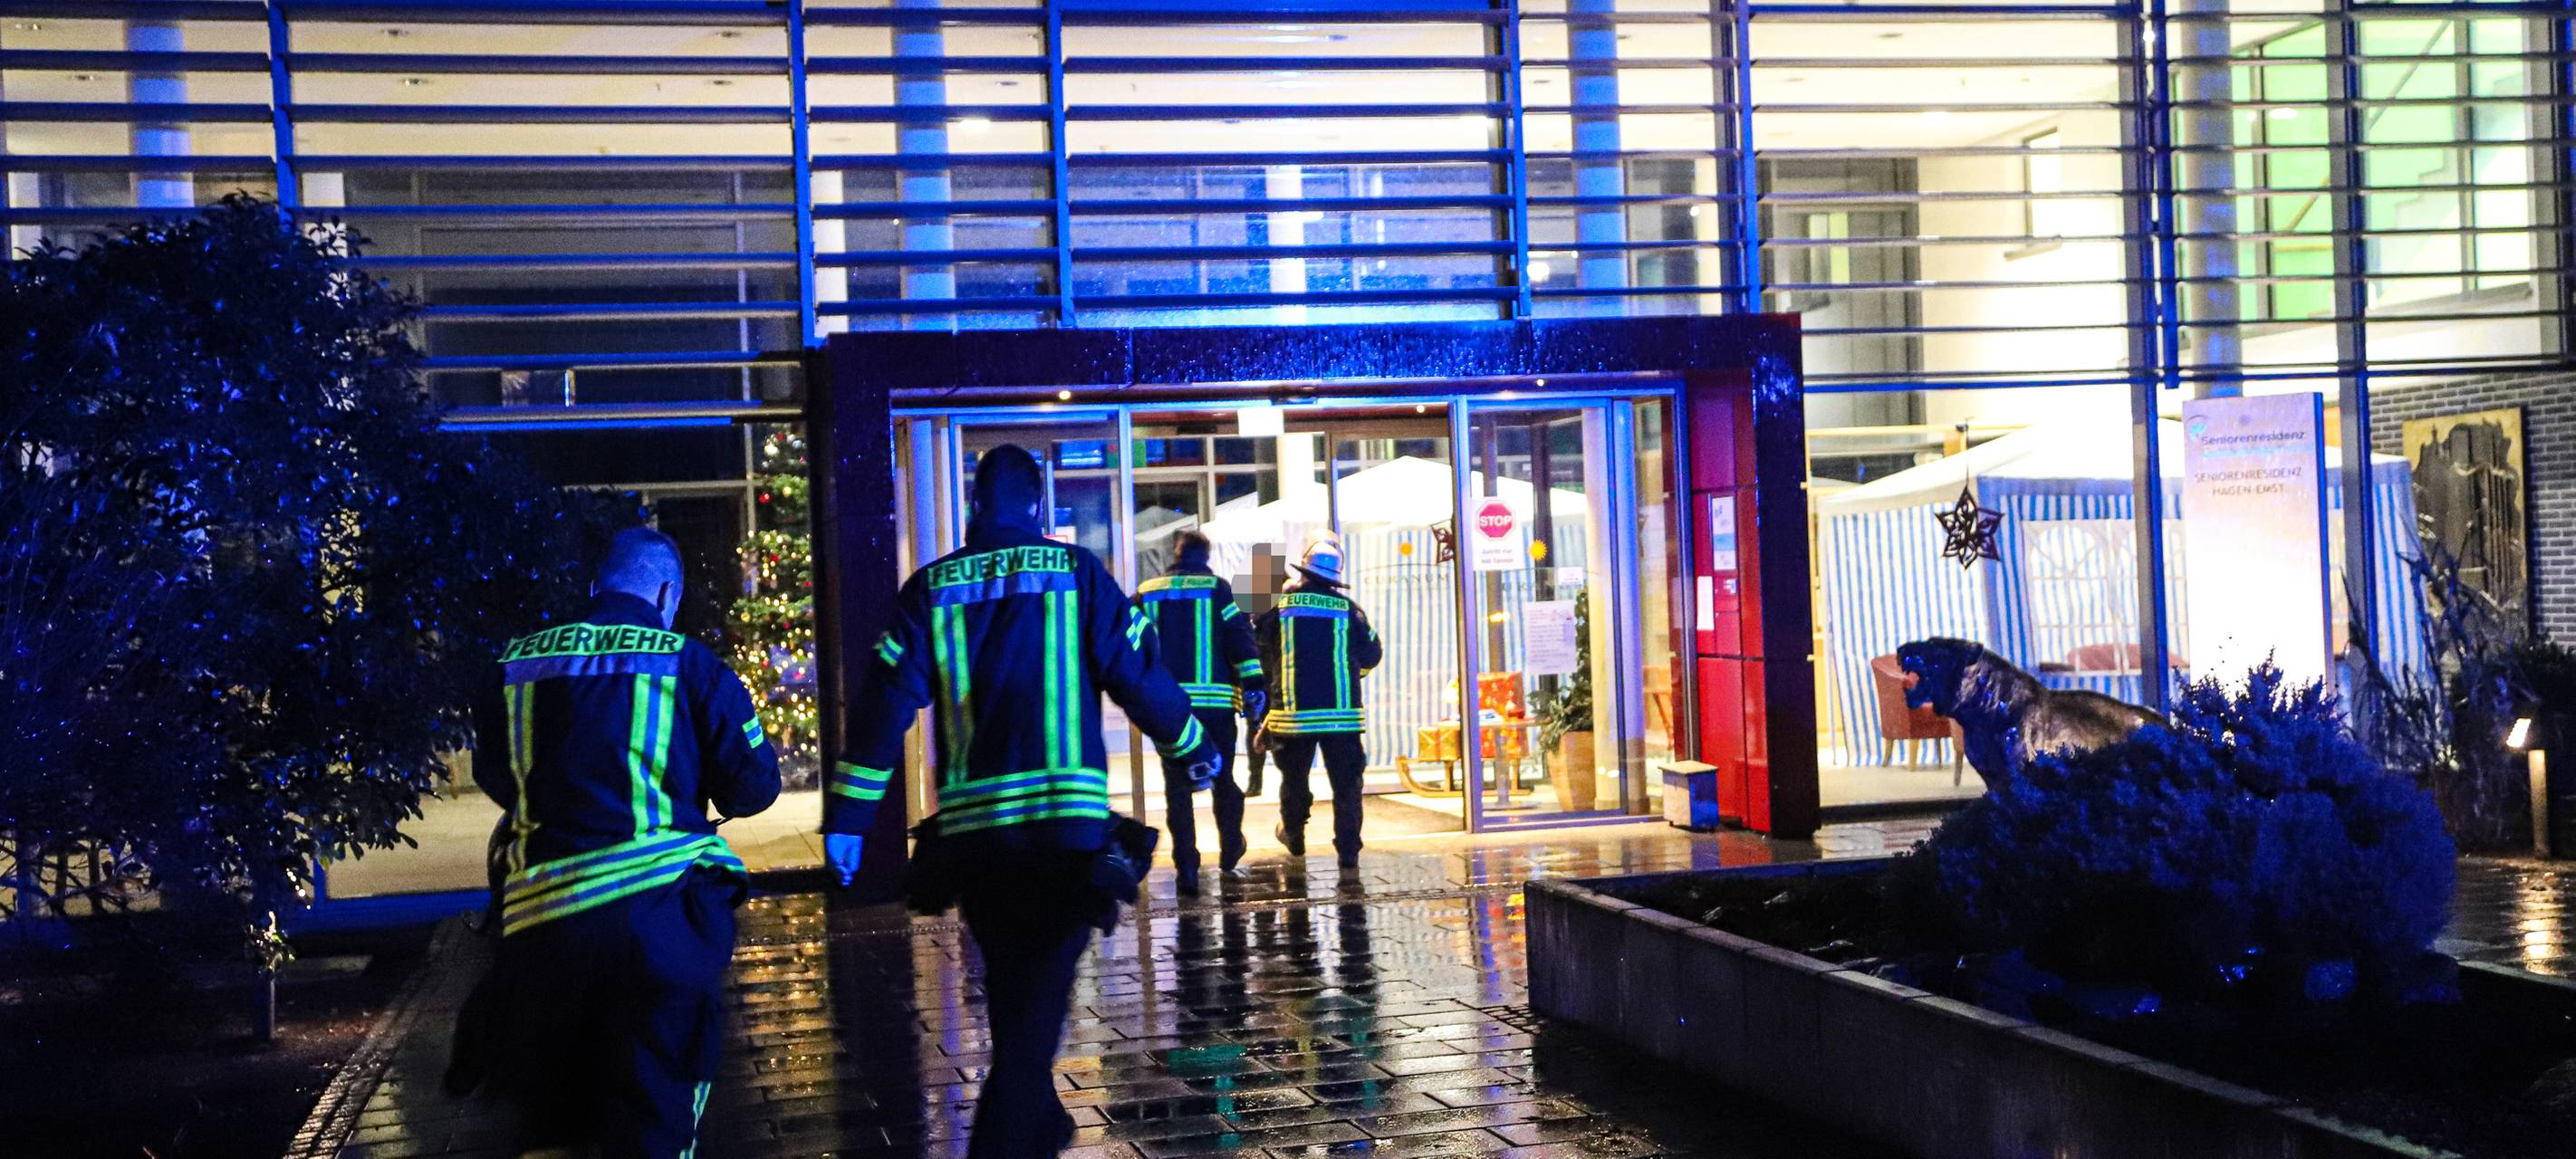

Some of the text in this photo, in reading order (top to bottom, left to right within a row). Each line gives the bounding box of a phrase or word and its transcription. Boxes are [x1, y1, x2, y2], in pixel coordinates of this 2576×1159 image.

[2201, 430, 2305, 445] Seniorenresidenz
[2194, 466, 2303, 483] SENIORENRESIDENZ
[1479, 515, 1513, 527] STOP
[931, 546, 1076, 587] FEUERWEHR
[507, 625, 679, 658] FEUERWEHR
